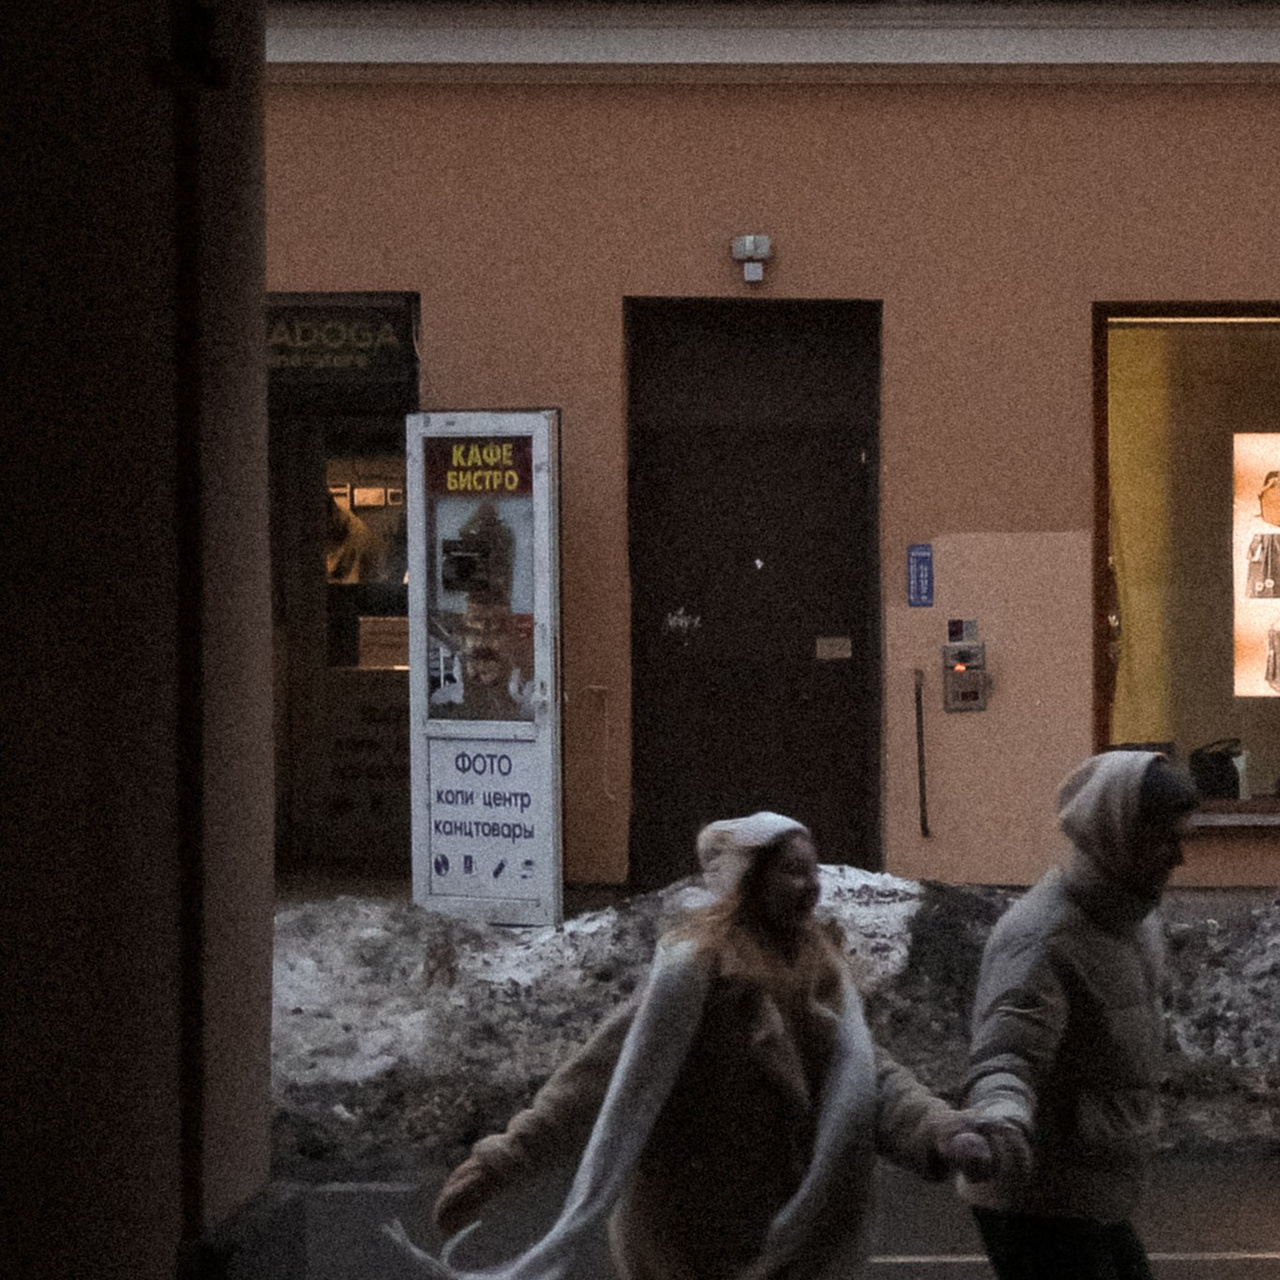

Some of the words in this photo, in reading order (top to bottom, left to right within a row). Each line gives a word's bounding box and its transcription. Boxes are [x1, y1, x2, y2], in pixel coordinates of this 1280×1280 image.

[266, 321, 400, 349] ADOGA
[452, 444, 513, 466] КАФЕ
[446, 470, 519, 491] БИСТРО
[455, 752, 512, 776] ФОТО
[436, 789, 474, 805] копи
[482, 791, 531, 813] центр
[434, 820, 535, 844] канцтовары
